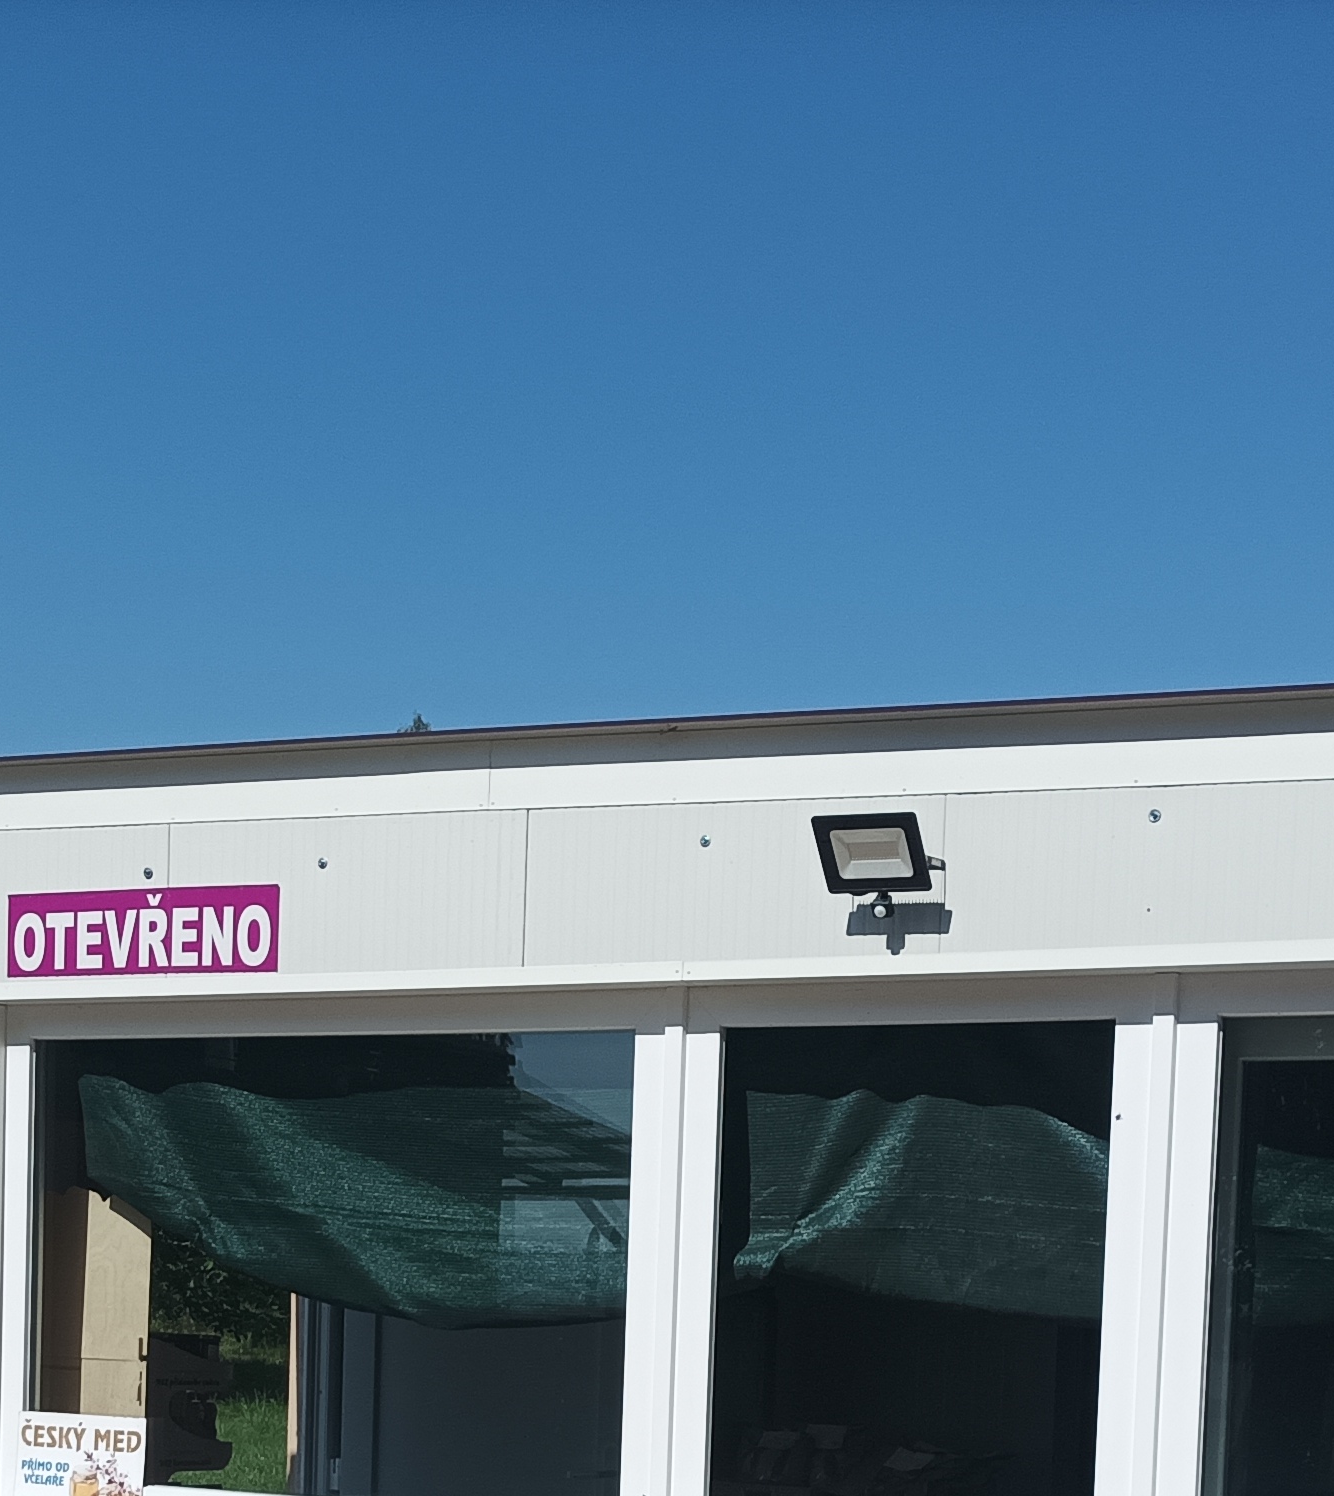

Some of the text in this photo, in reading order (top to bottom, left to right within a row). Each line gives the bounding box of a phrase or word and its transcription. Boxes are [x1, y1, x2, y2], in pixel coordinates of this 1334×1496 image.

[13, 893, 272, 972] OTEVŘENO
[21, 1418, 142, 1453] ČESKÝ MED
[21, 1457, 70, 1473] PŘÍMO OD
[24, 1472, 65, 1487] VČELAŘE
